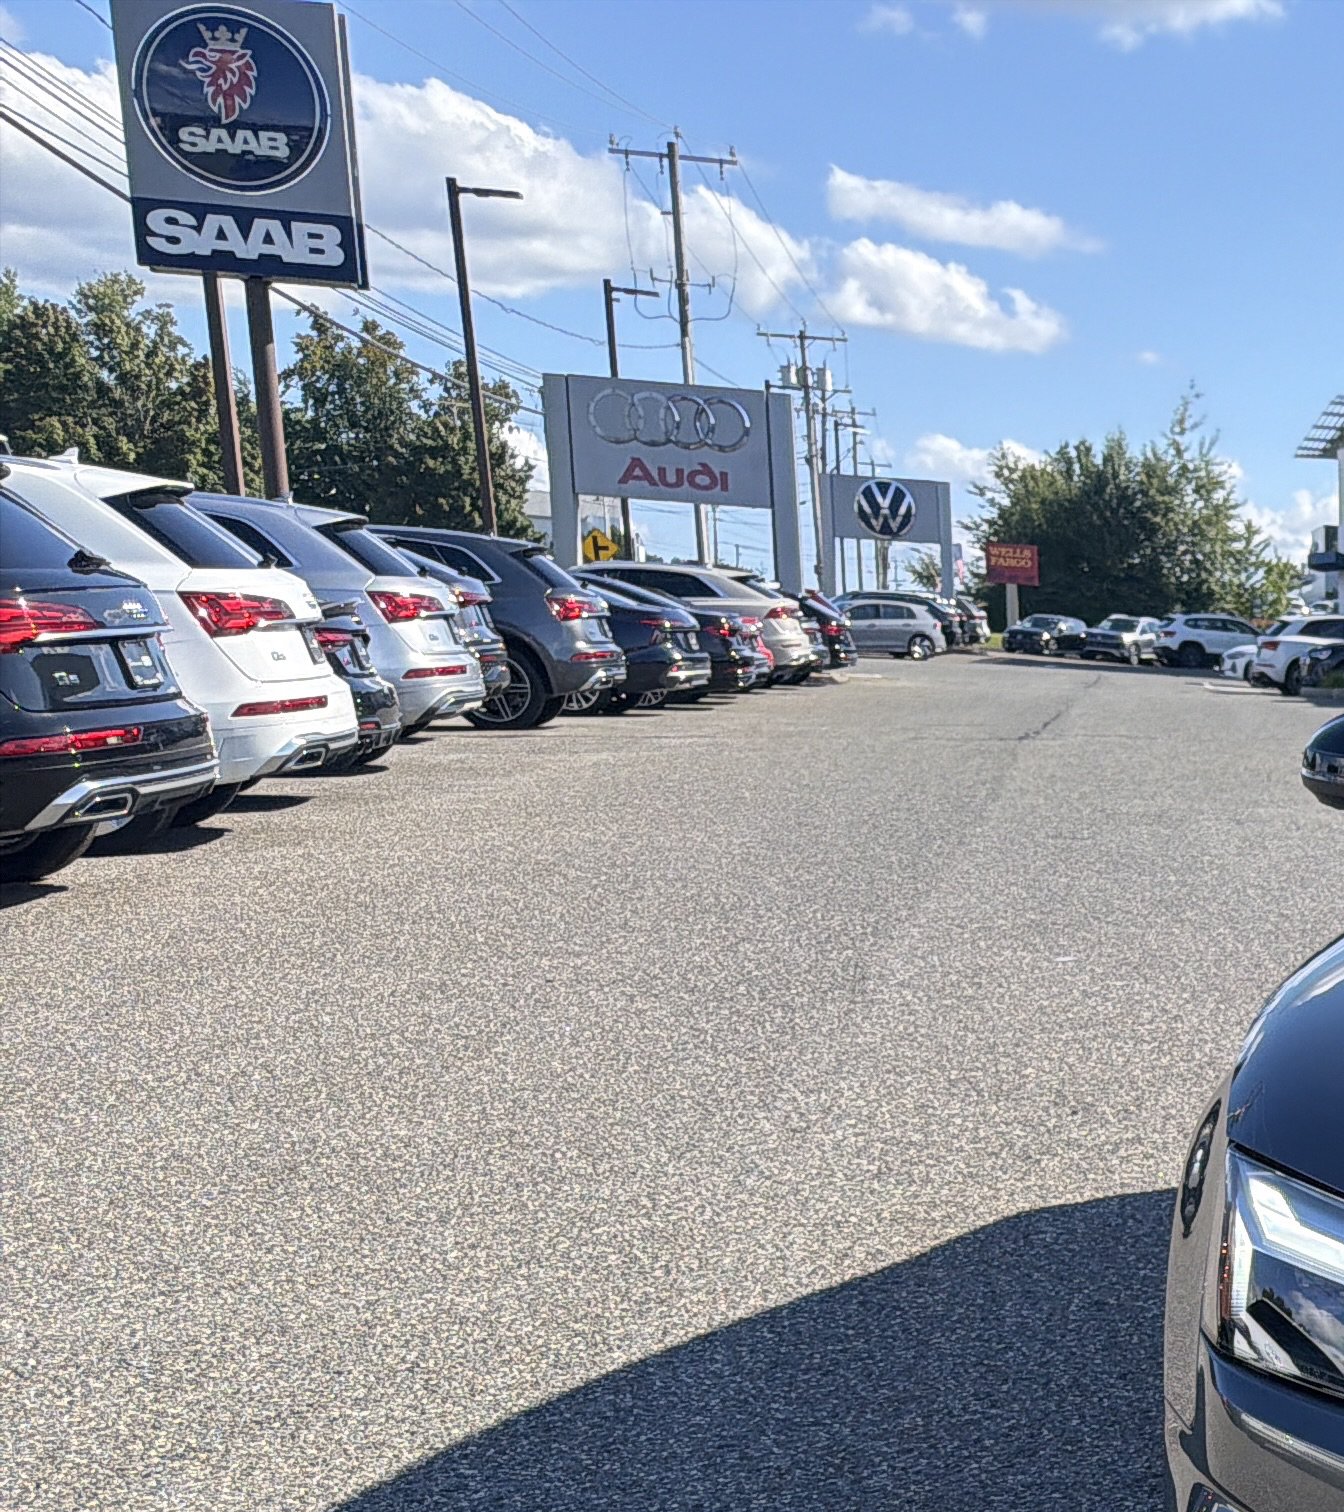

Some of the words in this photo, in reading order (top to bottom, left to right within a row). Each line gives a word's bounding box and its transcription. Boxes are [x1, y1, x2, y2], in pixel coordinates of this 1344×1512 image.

[178, 126, 290, 159] SAAB
[146, 208, 345, 266] SAAB
[617, 456, 729, 492] Audi
[988, 546, 1032, 558] WELLS
[990, 556, 1032, 568] FARGO
